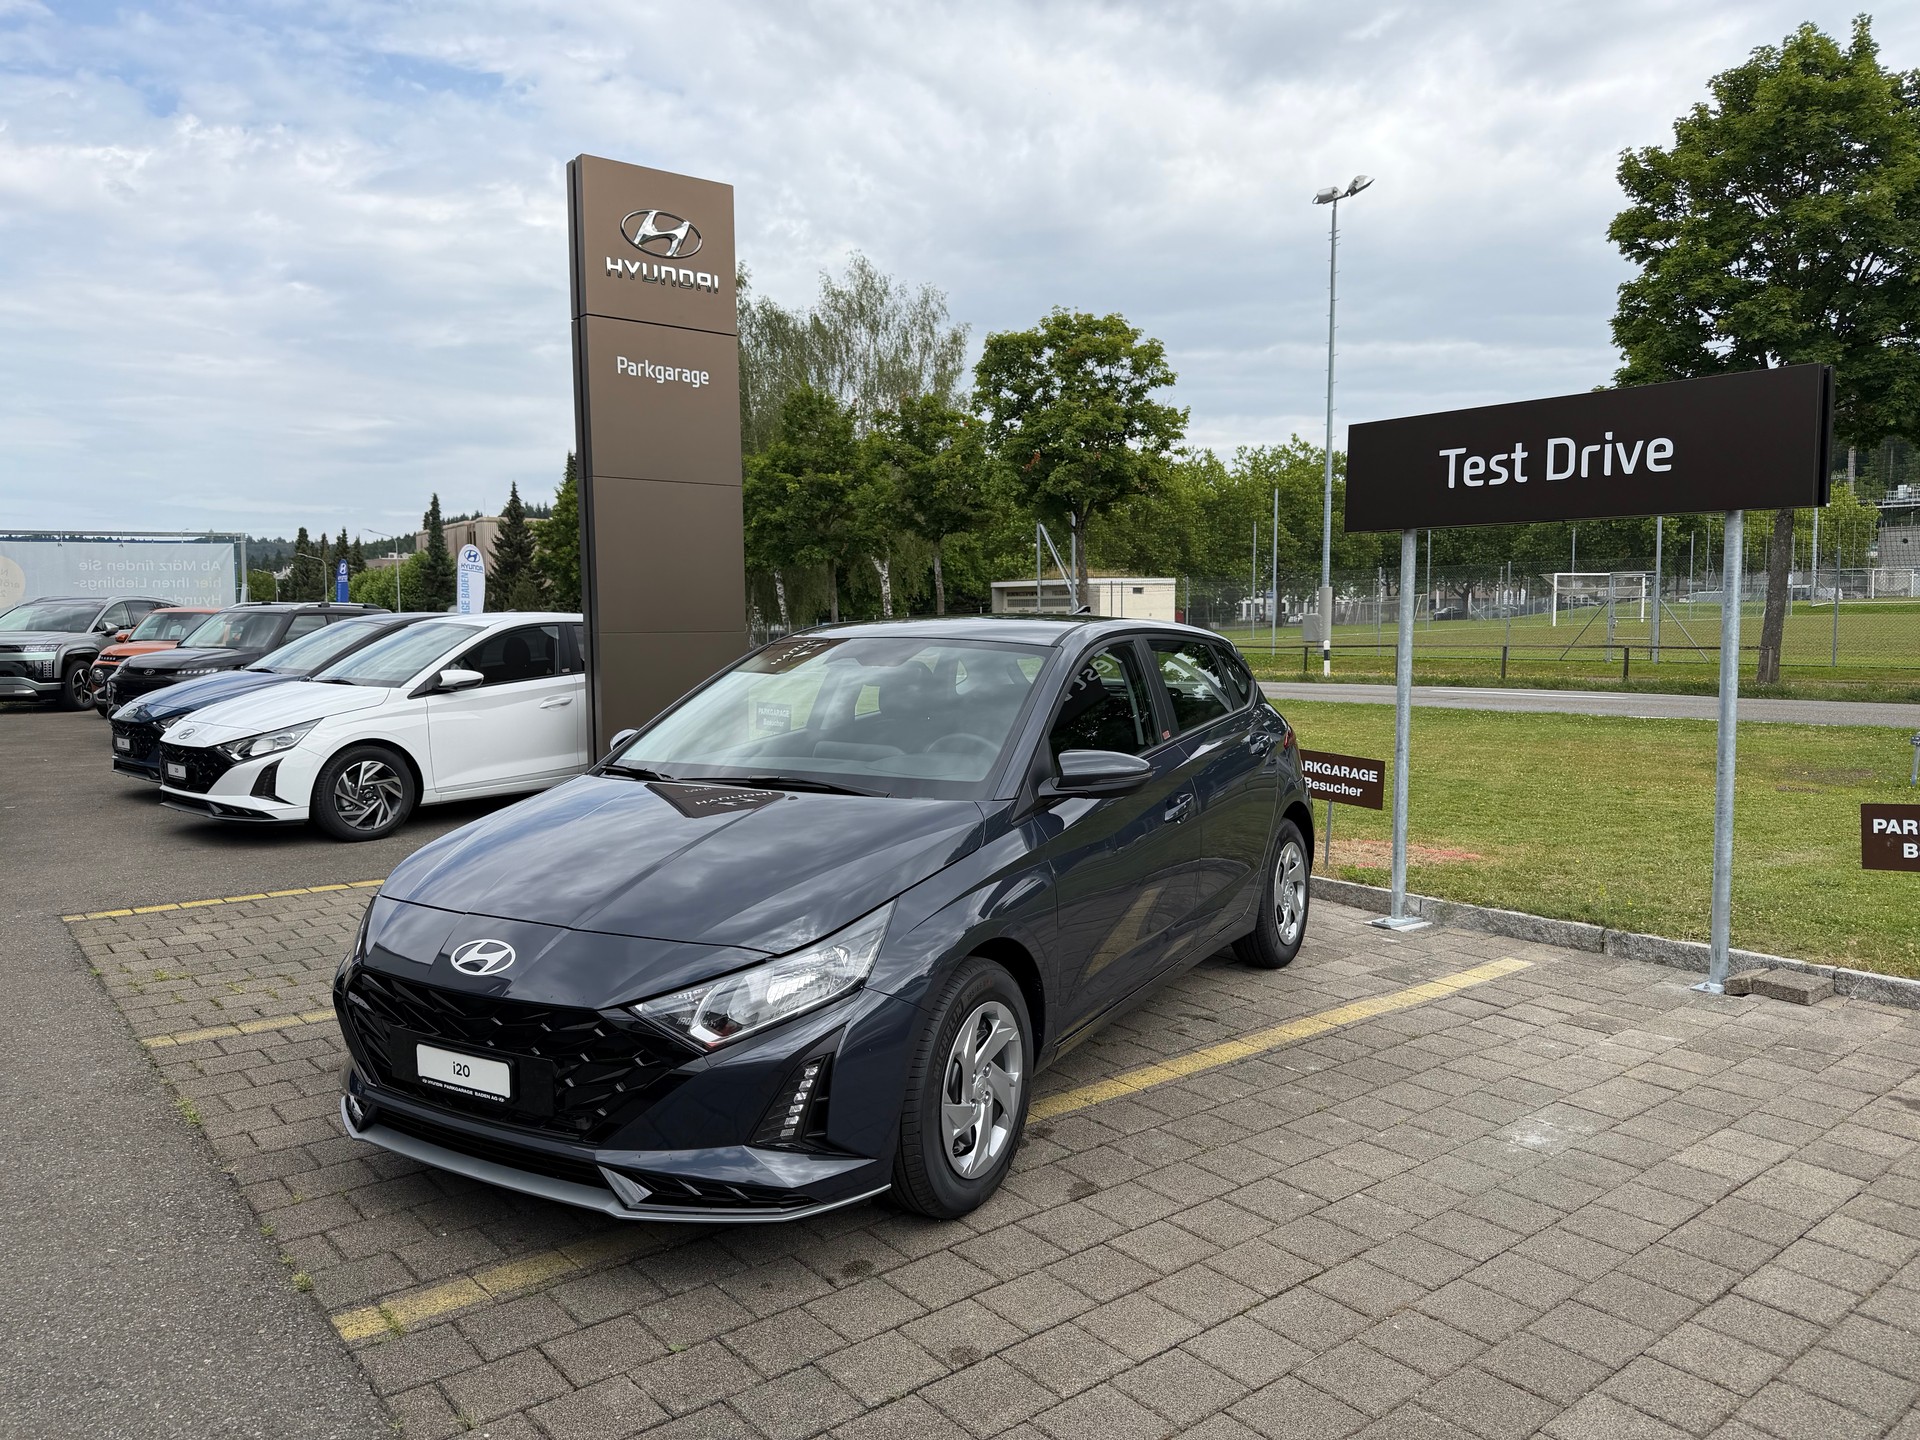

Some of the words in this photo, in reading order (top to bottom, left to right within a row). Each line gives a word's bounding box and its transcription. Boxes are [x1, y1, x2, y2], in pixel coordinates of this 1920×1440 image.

[605, 256, 719, 294] HYUNDAI
[617, 355, 710, 388] Parkgarage
[1439, 442, 1529, 489] Test
[1546, 432, 1674, 482] Drive
[461, 571, 470, 599] BADEN
[1300, 760, 1378, 783] RKGARAGE
[1304, 777, 1363, 797] Besucher
[1872, 818, 1920, 836] PAR
[452, 1061, 471, 1078] i20
[475, 1091, 491, 1099] BADEN
